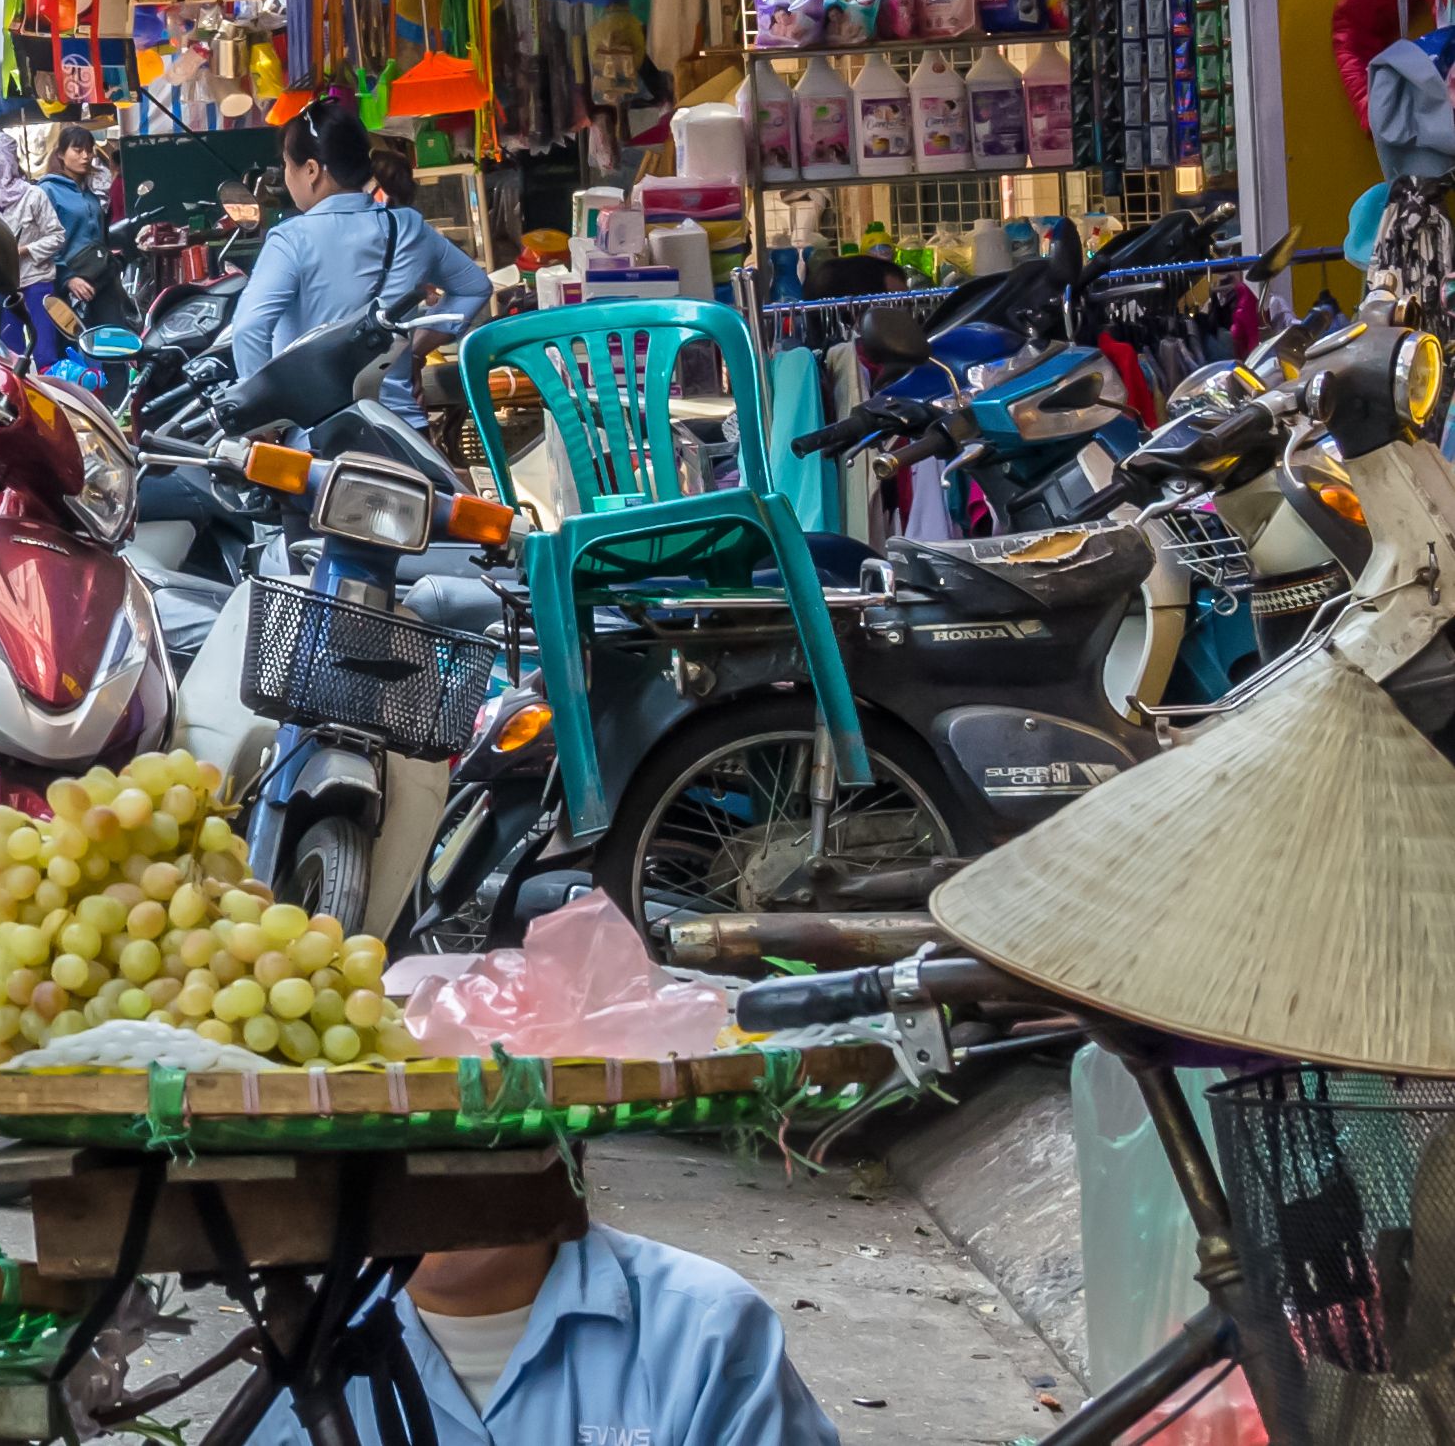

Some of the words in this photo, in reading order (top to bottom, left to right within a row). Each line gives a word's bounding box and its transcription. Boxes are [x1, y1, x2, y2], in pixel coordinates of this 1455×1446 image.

[932, 629, 1009, 642] HONDA
[985, 766, 1049, 777] SUPER
[1010, 775, 1050, 785] CUB
